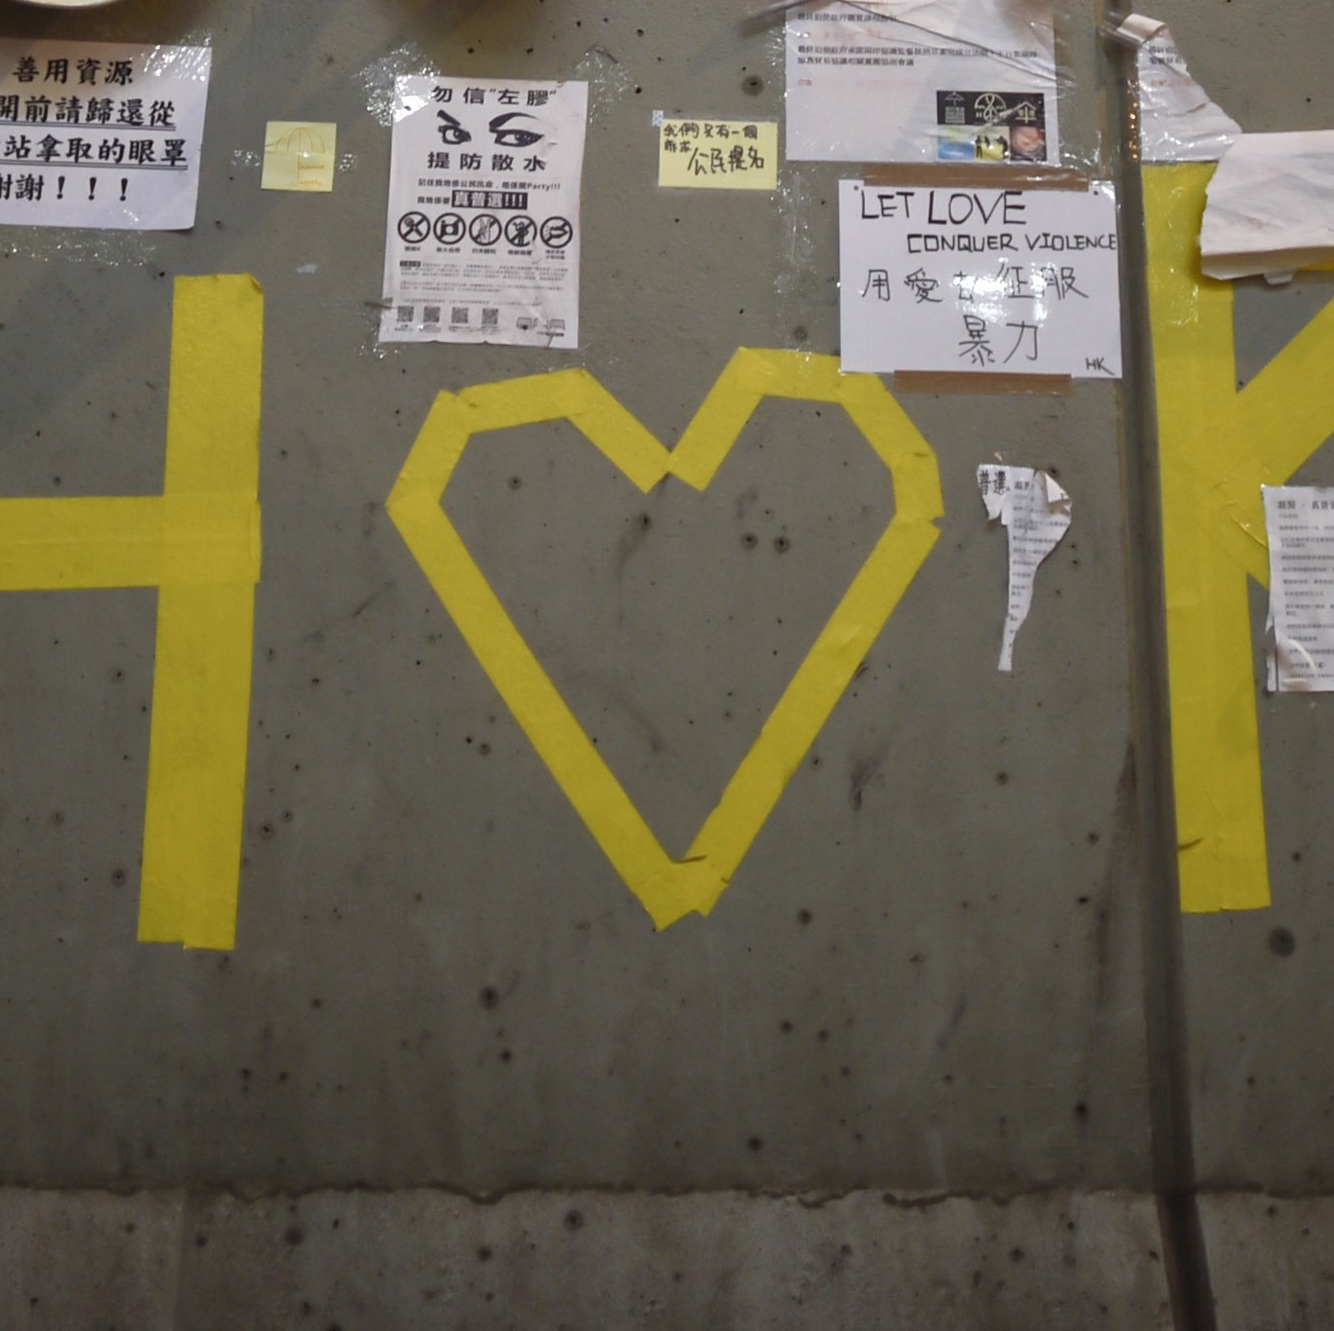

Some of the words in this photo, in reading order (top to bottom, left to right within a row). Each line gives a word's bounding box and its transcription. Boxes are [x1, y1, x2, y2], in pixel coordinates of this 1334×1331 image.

[11, 56, 135, 86] 善用資源
[427, 151, 548, 173] 提防散水
[687, 145, 765, 176] 公民提名
[860, 189, 914, 220] LET
[927, 188, 1026, 225] LOVE
[907, 233, 1020, 254] CONQUER
[1025, 232, 1117, 253] VIOLENCE
[959, 315, 1041, 366] 暴力
[1085, 356, 1108, 372] HK
